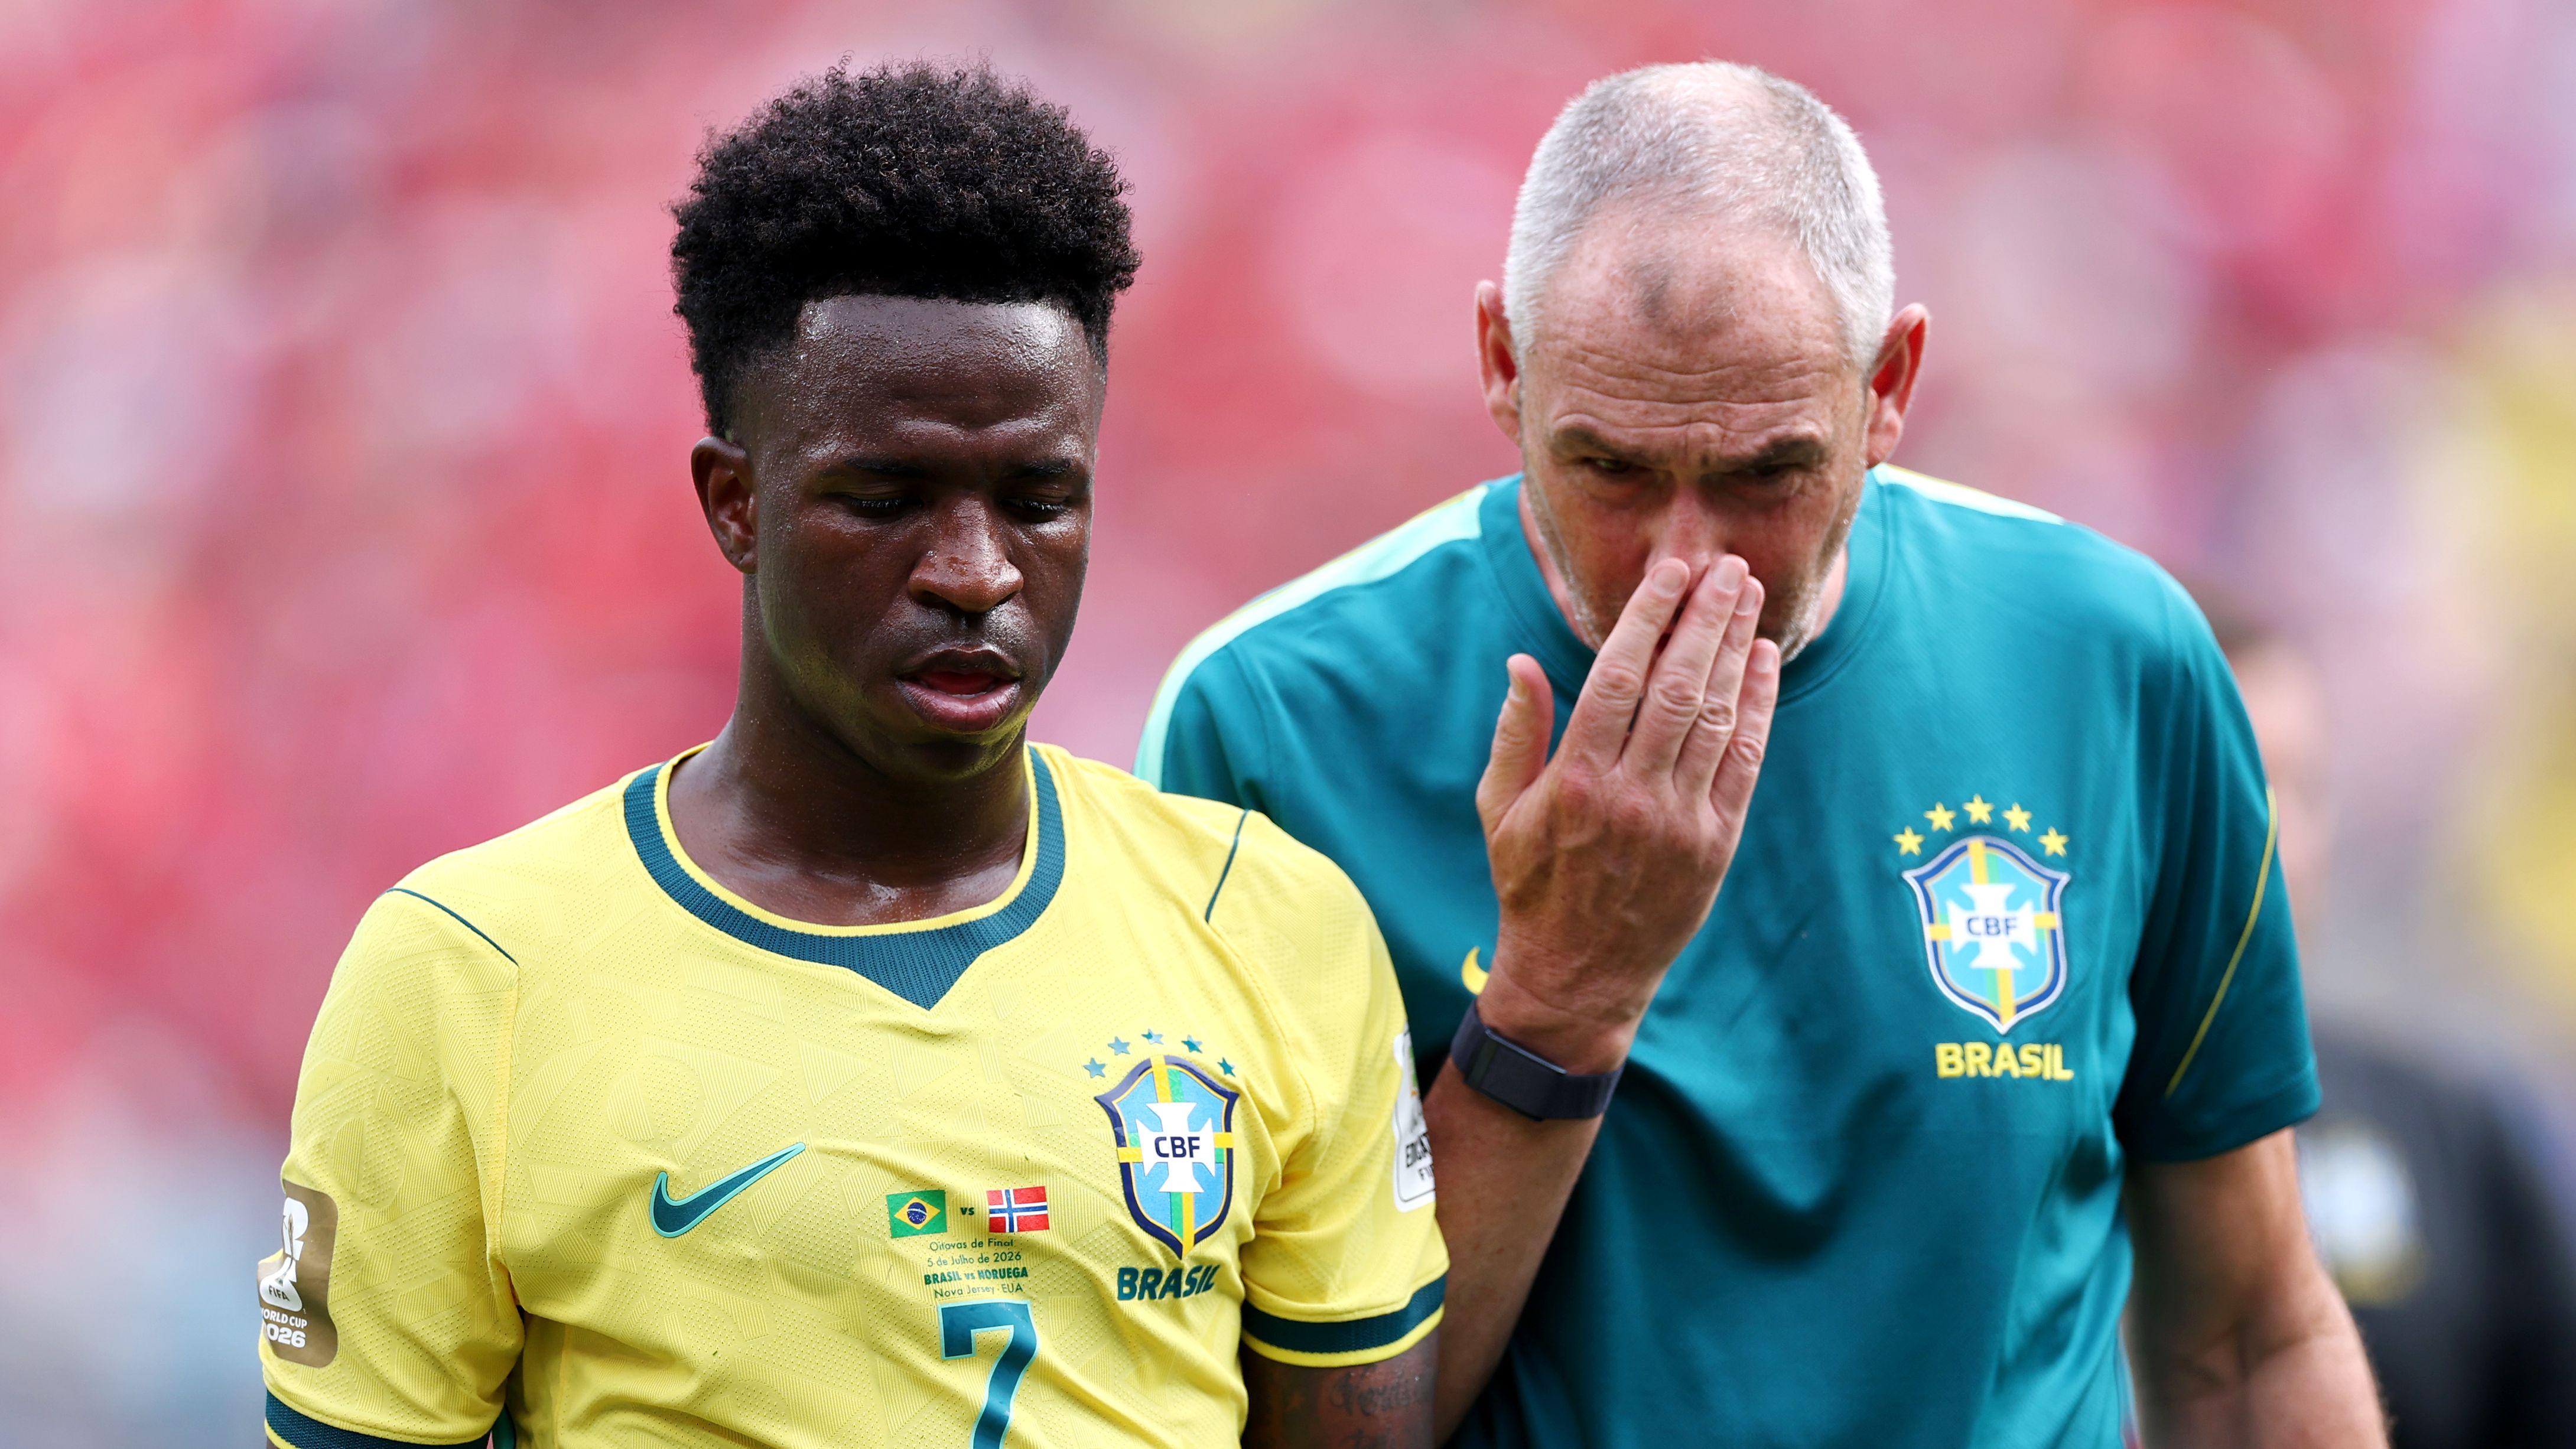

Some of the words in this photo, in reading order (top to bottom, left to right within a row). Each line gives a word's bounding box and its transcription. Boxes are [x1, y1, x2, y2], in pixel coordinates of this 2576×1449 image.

[1966, 916, 2020, 936] CBF
[1935, 1041, 2074, 1081] BRASIL
[1154, 1136, 1201, 1158] CBF
[960, 1207, 975, 1216] vs
[971, 1238, 984, 1248] de
[988, 1238, 1014, 1247] Final
[928, 1258, 934, 1267] 5
[936, 1256, 948, 1266] de
[951, 1255, 974, 1265] Julho
[978, 1253, 990, 1264] de
[993, 1251, 1022, 1262] 2026
[924, 1271, 962, 1285] BRASIL
[977, 1266, 1029, 1279] NORUEGA
[1117, 1265, 1220, 1301] BRASIL
[268, 1285, 291, 1303] FIFA
[934, 1288, 963, 1298] Nova
[967, 1284, 994, 1294] Jersey
[1001, 1283, 1023, 1293] EUA
[289, 1316, 307, 1329] CUP
[266, 1323, 306, 1348] 026
[937, 1300, 1039, 1449] 7
